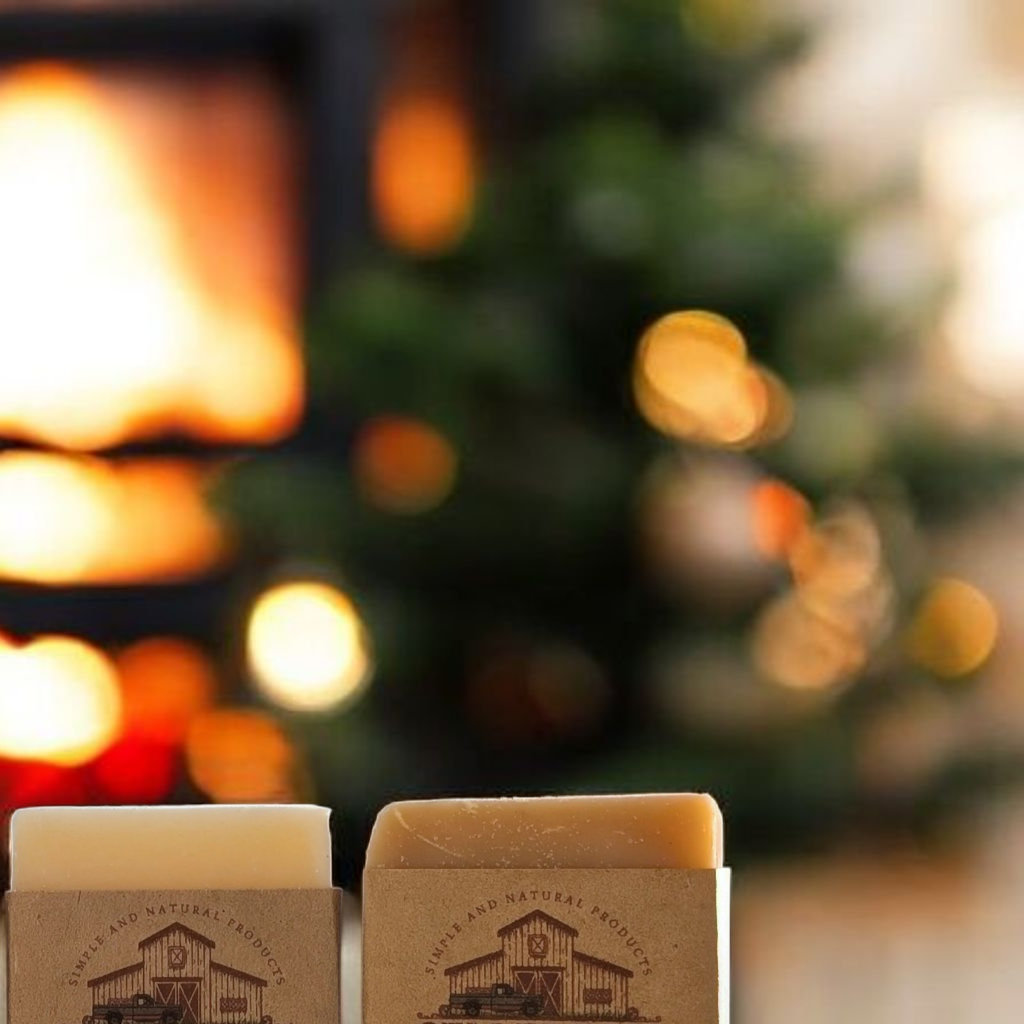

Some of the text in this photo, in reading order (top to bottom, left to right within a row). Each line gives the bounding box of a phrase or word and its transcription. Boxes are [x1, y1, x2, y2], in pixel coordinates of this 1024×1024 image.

[69, 904, 285, 987] SIMPLE AND NATURAL PRODUCTS
[425, 891, 652, 976] SIMPLE AND NATURAL PRODUCTS
